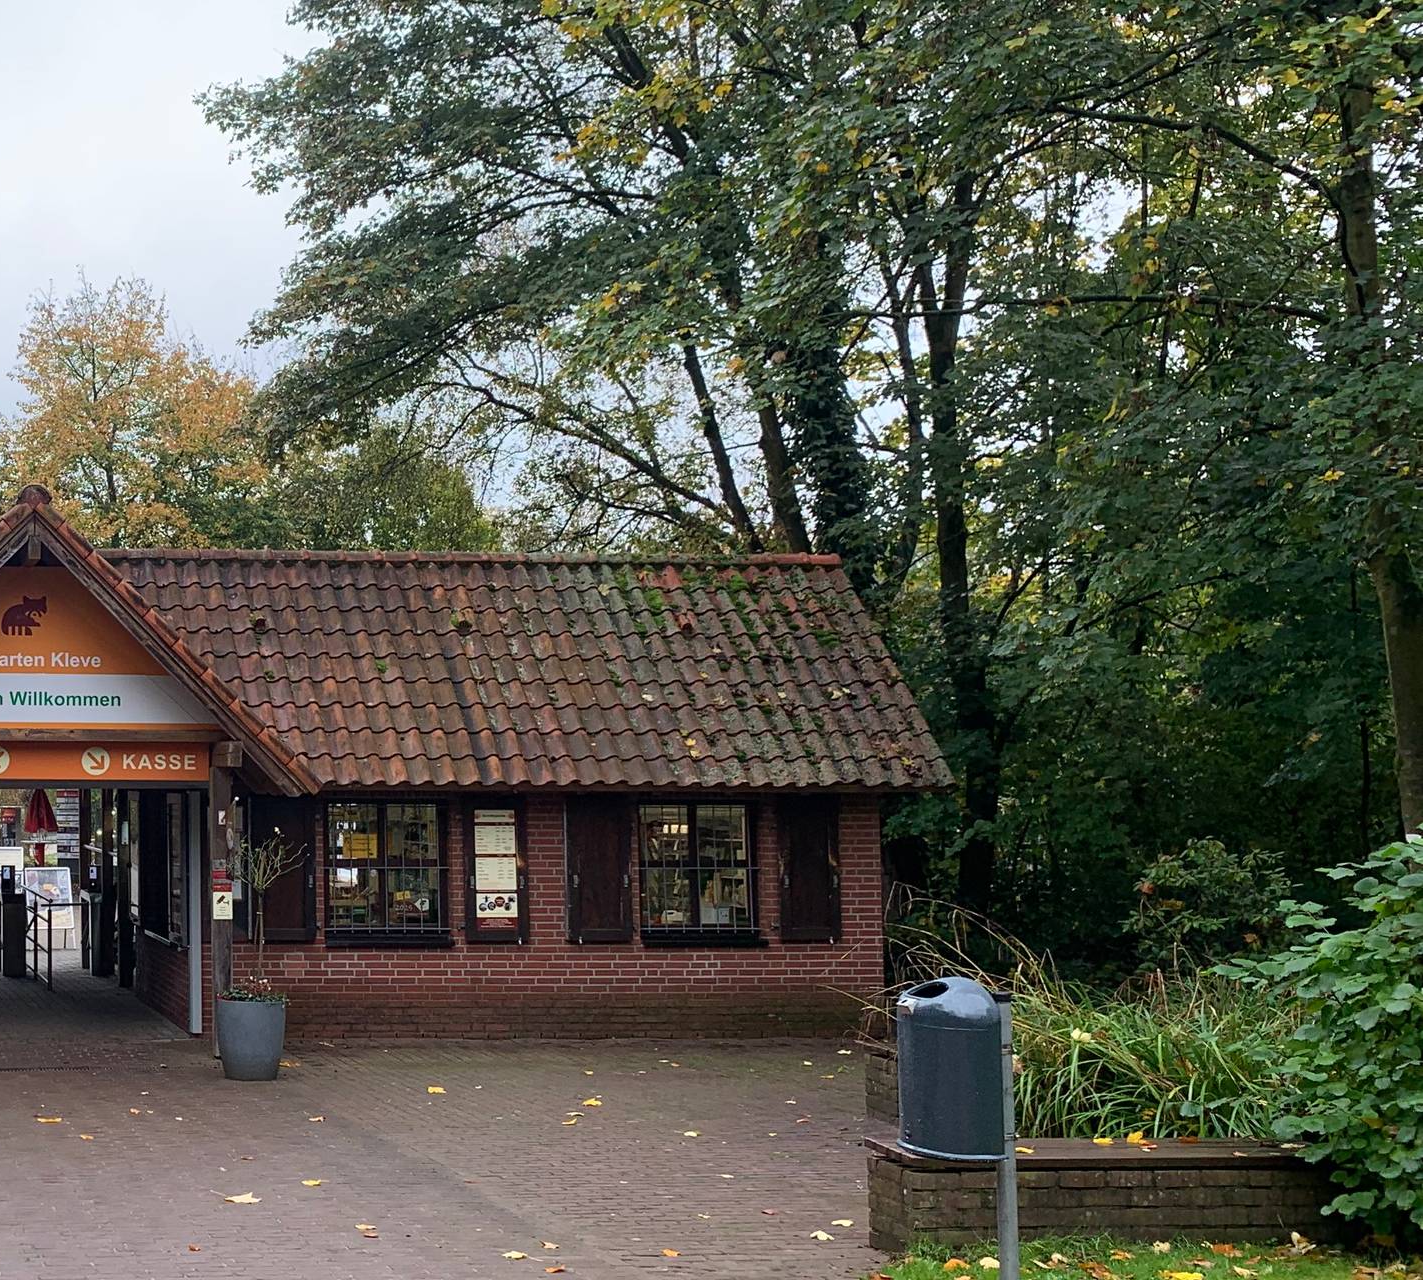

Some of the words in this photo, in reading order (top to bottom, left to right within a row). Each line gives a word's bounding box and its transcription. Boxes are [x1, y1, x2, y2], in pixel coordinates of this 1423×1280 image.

[51, 652, 102, 668] Kleve
[10, 691, 122, 707] Willkommen
[122, 753, 197, 770] KASSE
